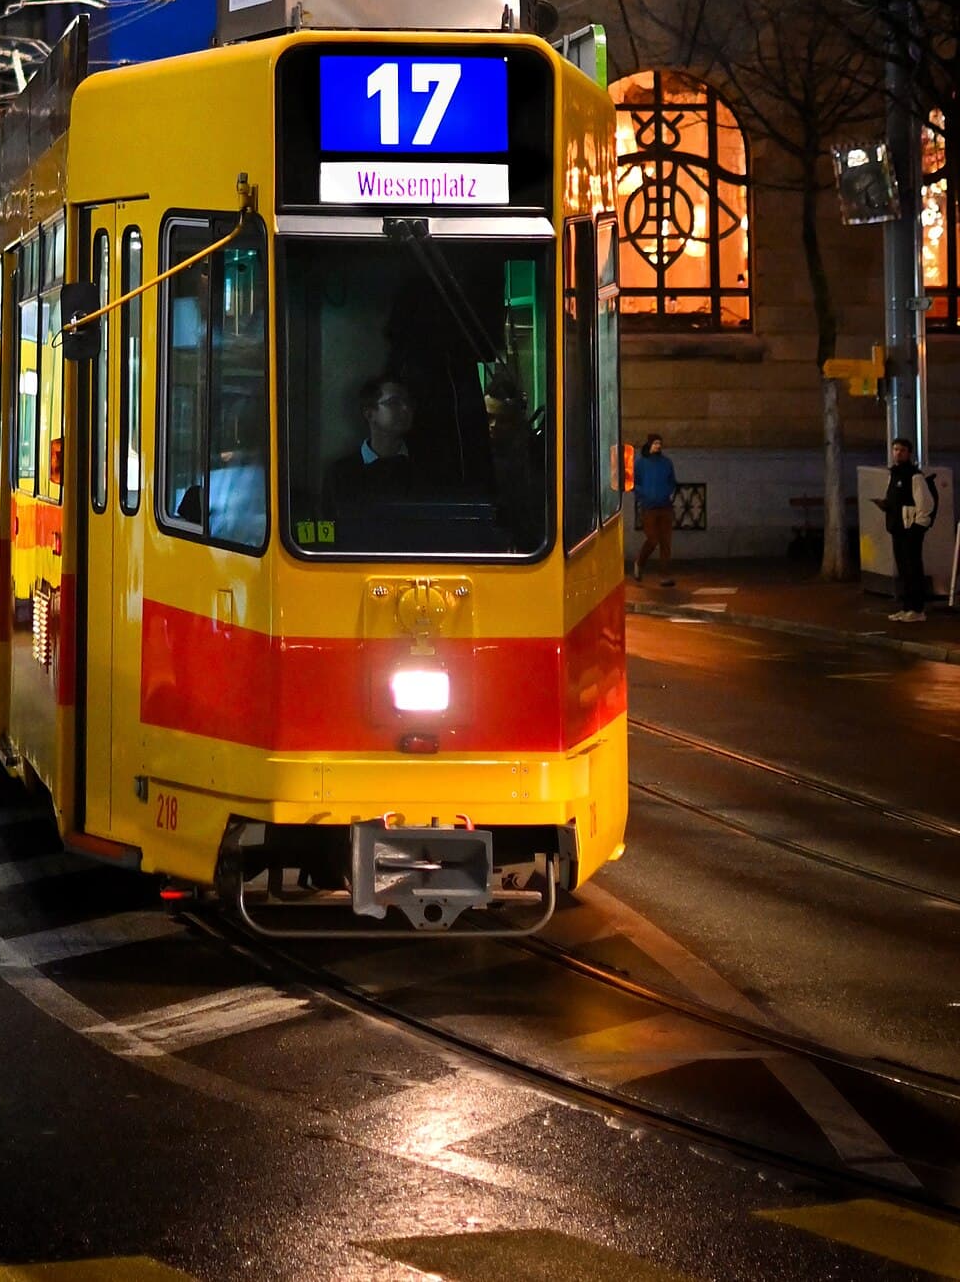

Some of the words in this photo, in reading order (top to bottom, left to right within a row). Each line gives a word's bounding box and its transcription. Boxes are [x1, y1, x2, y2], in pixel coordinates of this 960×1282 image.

[367, 63, 461, 145] 17
[358, 171, 477, 204] Wiesenplatz
[156, 793, 178, 831] 218
